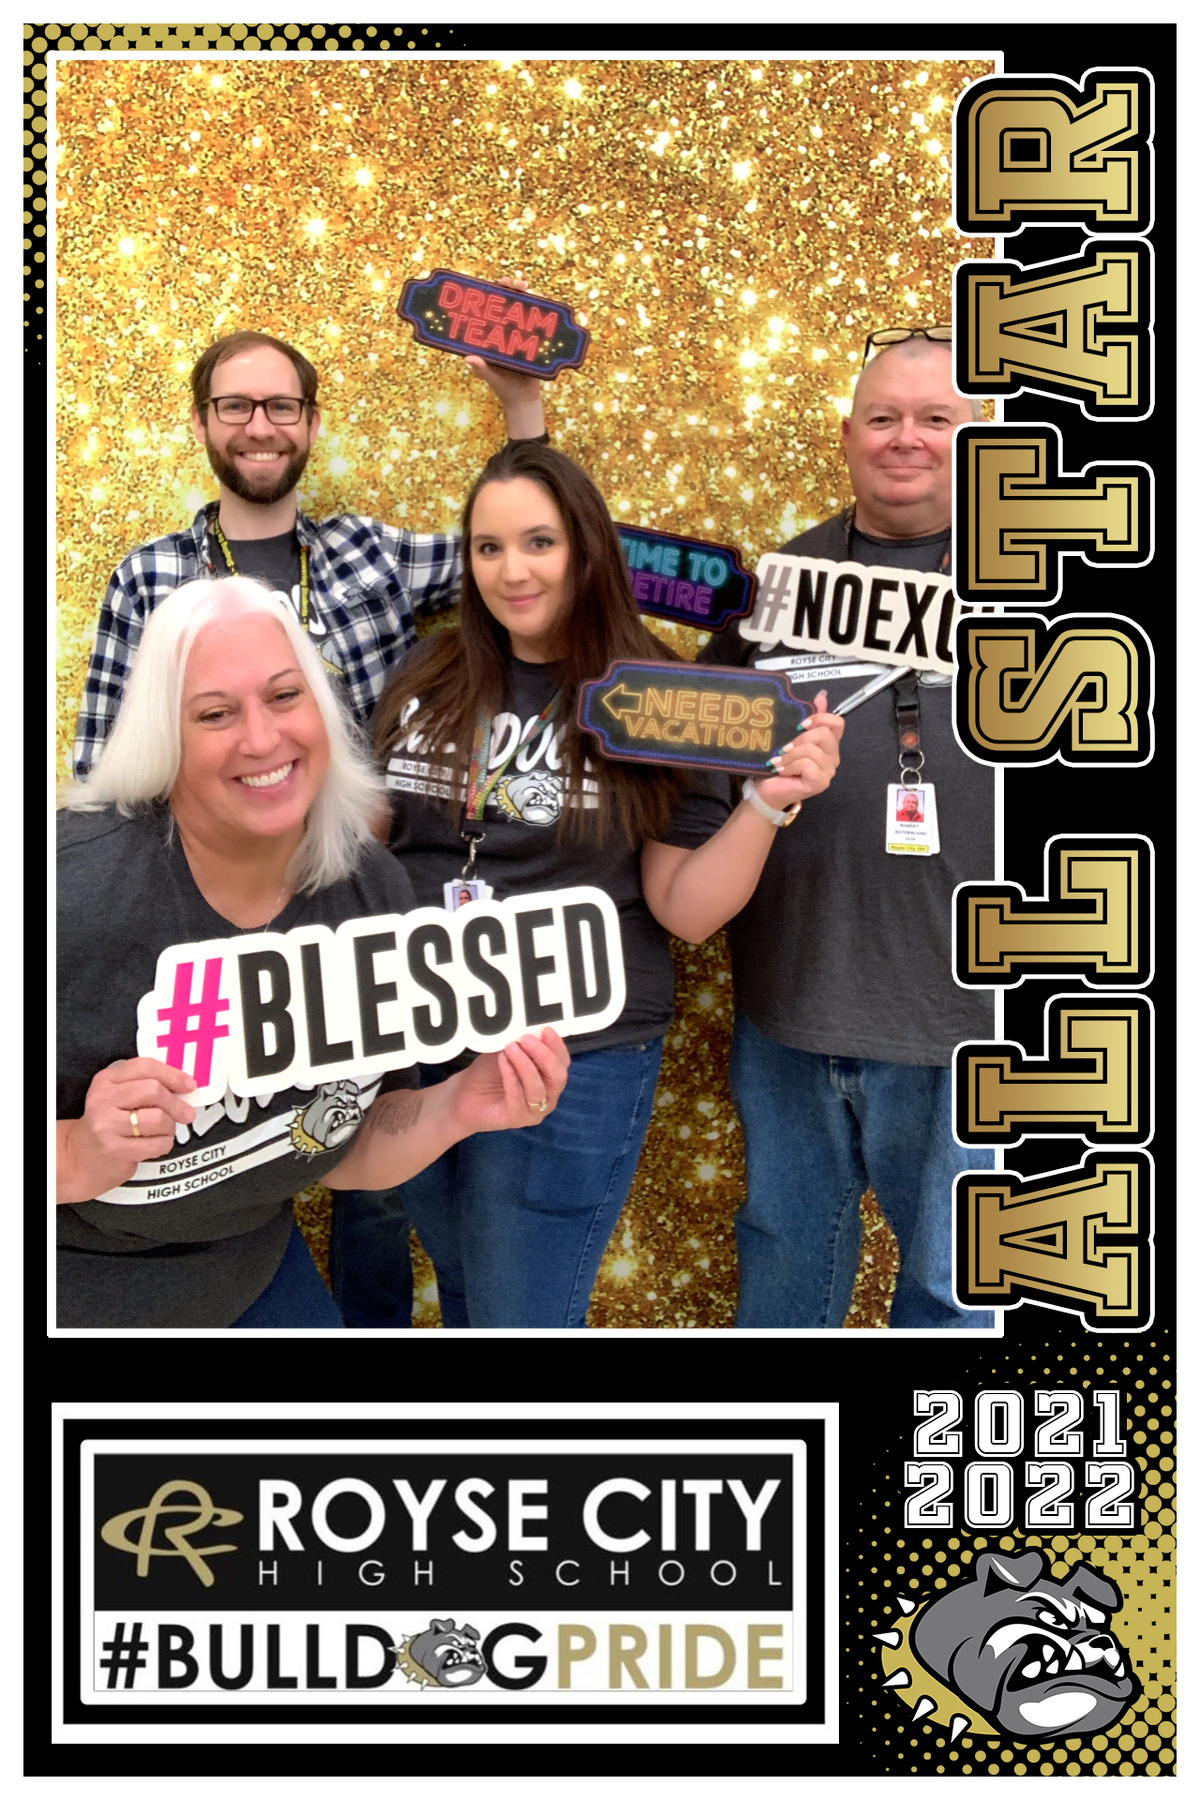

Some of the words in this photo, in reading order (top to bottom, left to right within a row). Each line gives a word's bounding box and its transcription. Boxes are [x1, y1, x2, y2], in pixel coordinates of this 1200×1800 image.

[438, 281, 558, 338] DREAM
[447, 311, 540, 362] TEAM
[688, 551, 728, 587] TO
[790, 656, 817, 665] ROYSE
[818, 655, 837, 663] CITY
[806, 669, 842, 679] SCHOOL
[645, 687, 774, 728] NEEDS
[394, 779, 412, 789] HIGH
[413, 782, 450, 796] SCOOL
[156, 901, 612, 1089] #BLESSED
[159, 1157, 199, 1175] ROYSE
[201, 1145, 227, 1163] CITY
[147, 1185, 181, 1200] HIGH
[184, 1165, 235, 1192] SCHOOL
